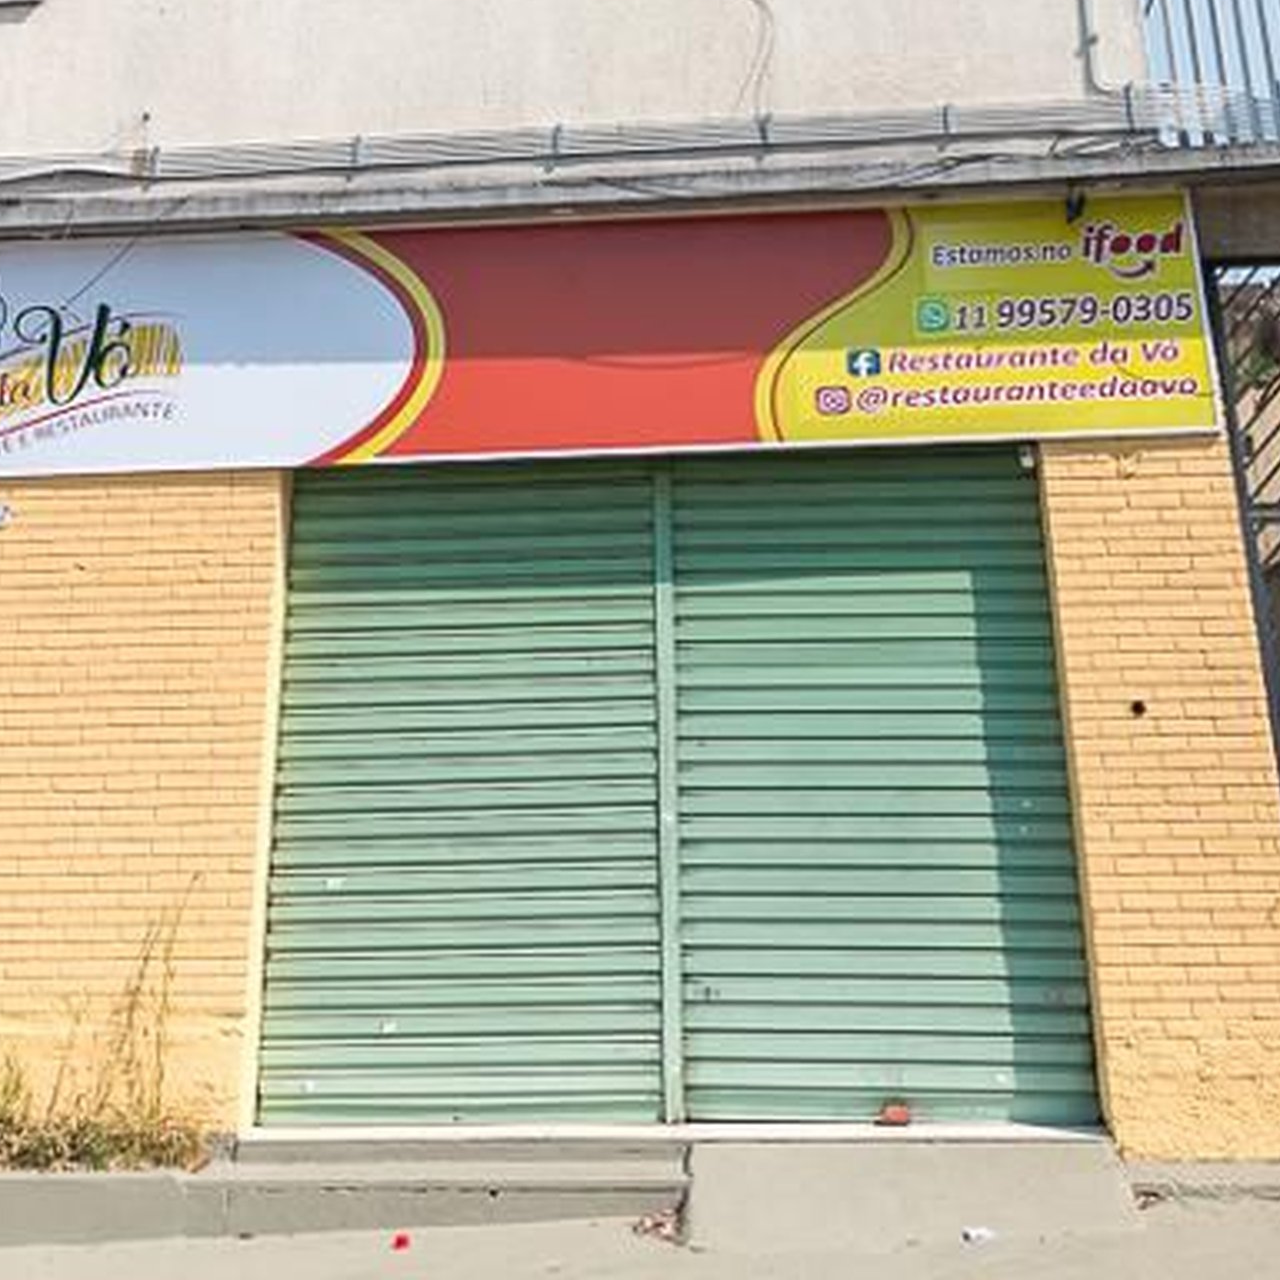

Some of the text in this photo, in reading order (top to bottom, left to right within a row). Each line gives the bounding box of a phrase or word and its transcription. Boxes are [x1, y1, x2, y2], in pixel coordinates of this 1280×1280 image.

[932, 221, 1183, 266] Estamos no ifood
[956, 292, 1193, 330] 11 99579-0305
[889, 347, 1079, 373] Restaurante
[1089, 341, 1128, 365] da
[32, 400, 176, 439] RESTAURANTE
